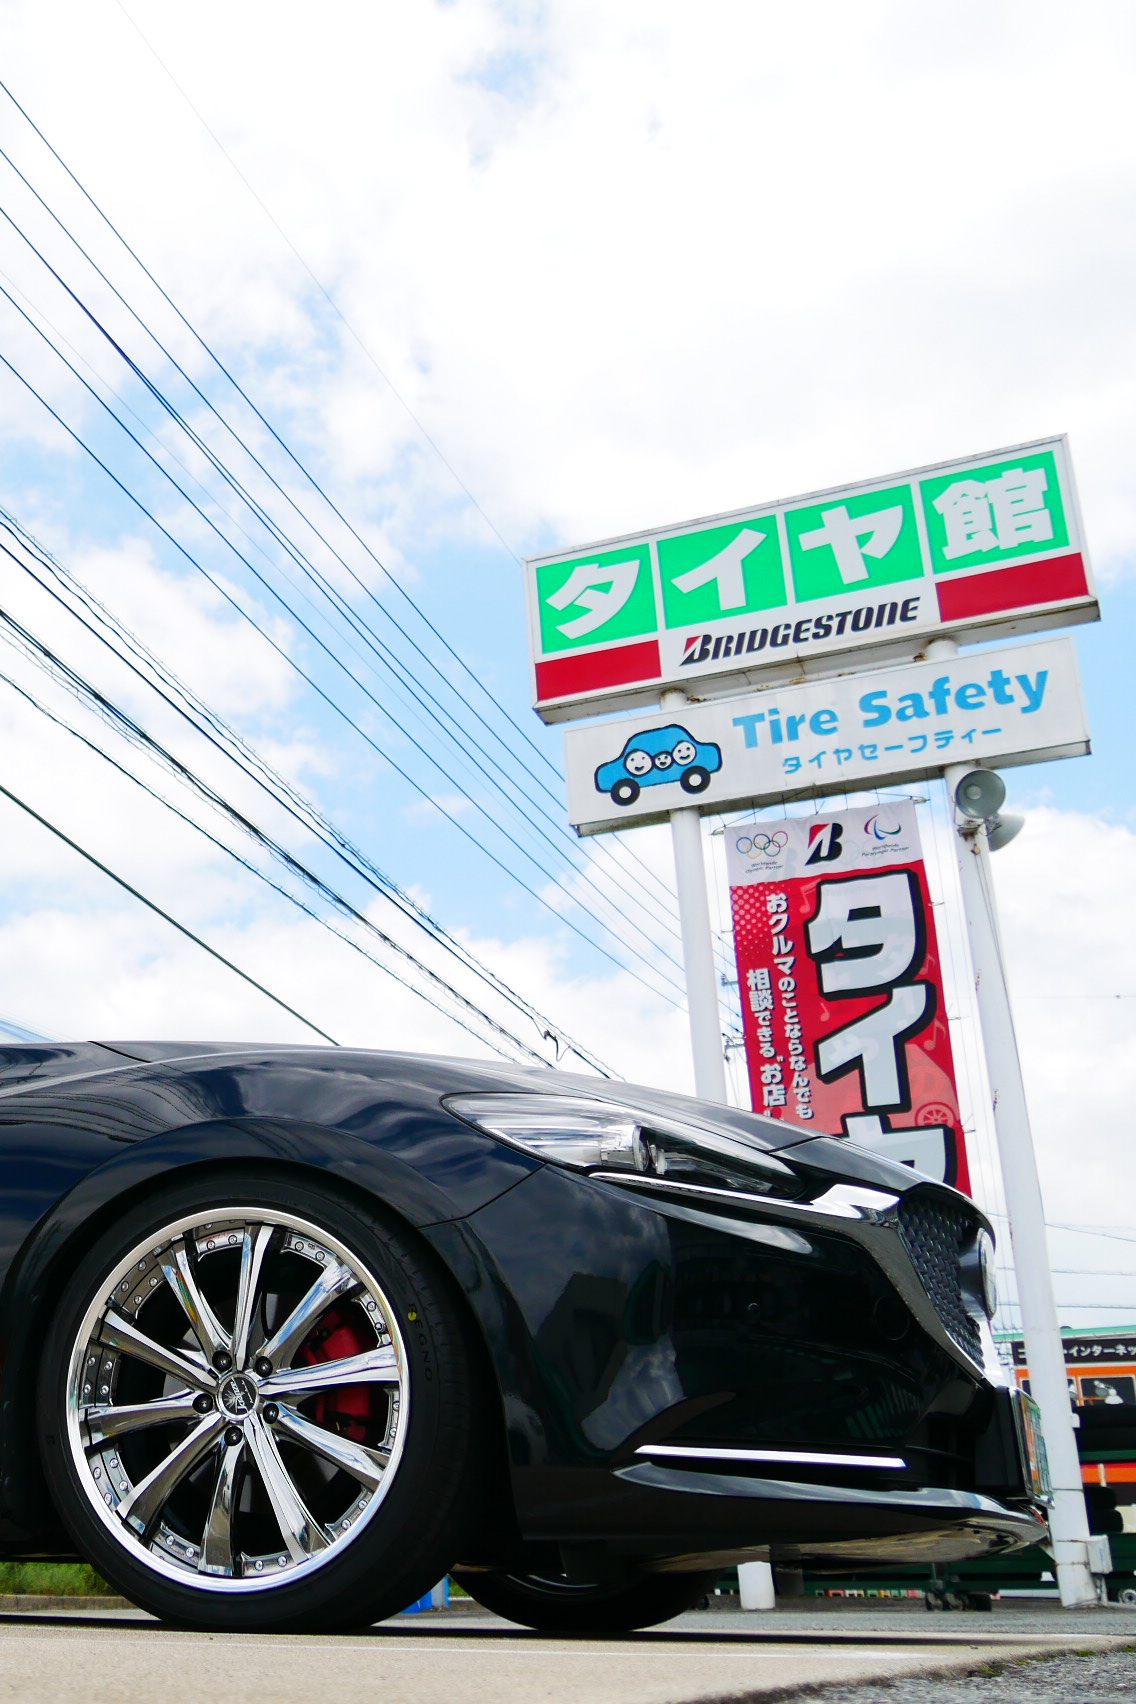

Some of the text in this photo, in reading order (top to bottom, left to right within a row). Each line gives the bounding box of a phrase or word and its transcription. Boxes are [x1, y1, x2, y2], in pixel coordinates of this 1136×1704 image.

[545, 467, 1055, 640] タイヤ館
[679, 596, 921, 667] BRIDGESTONE
[732, 669, 1049, 750] Tire Safety
[782, 727, 1003, 775] タイヤセーフティー
[766, 892, 814, 1120] おクルマのことならなんでも
